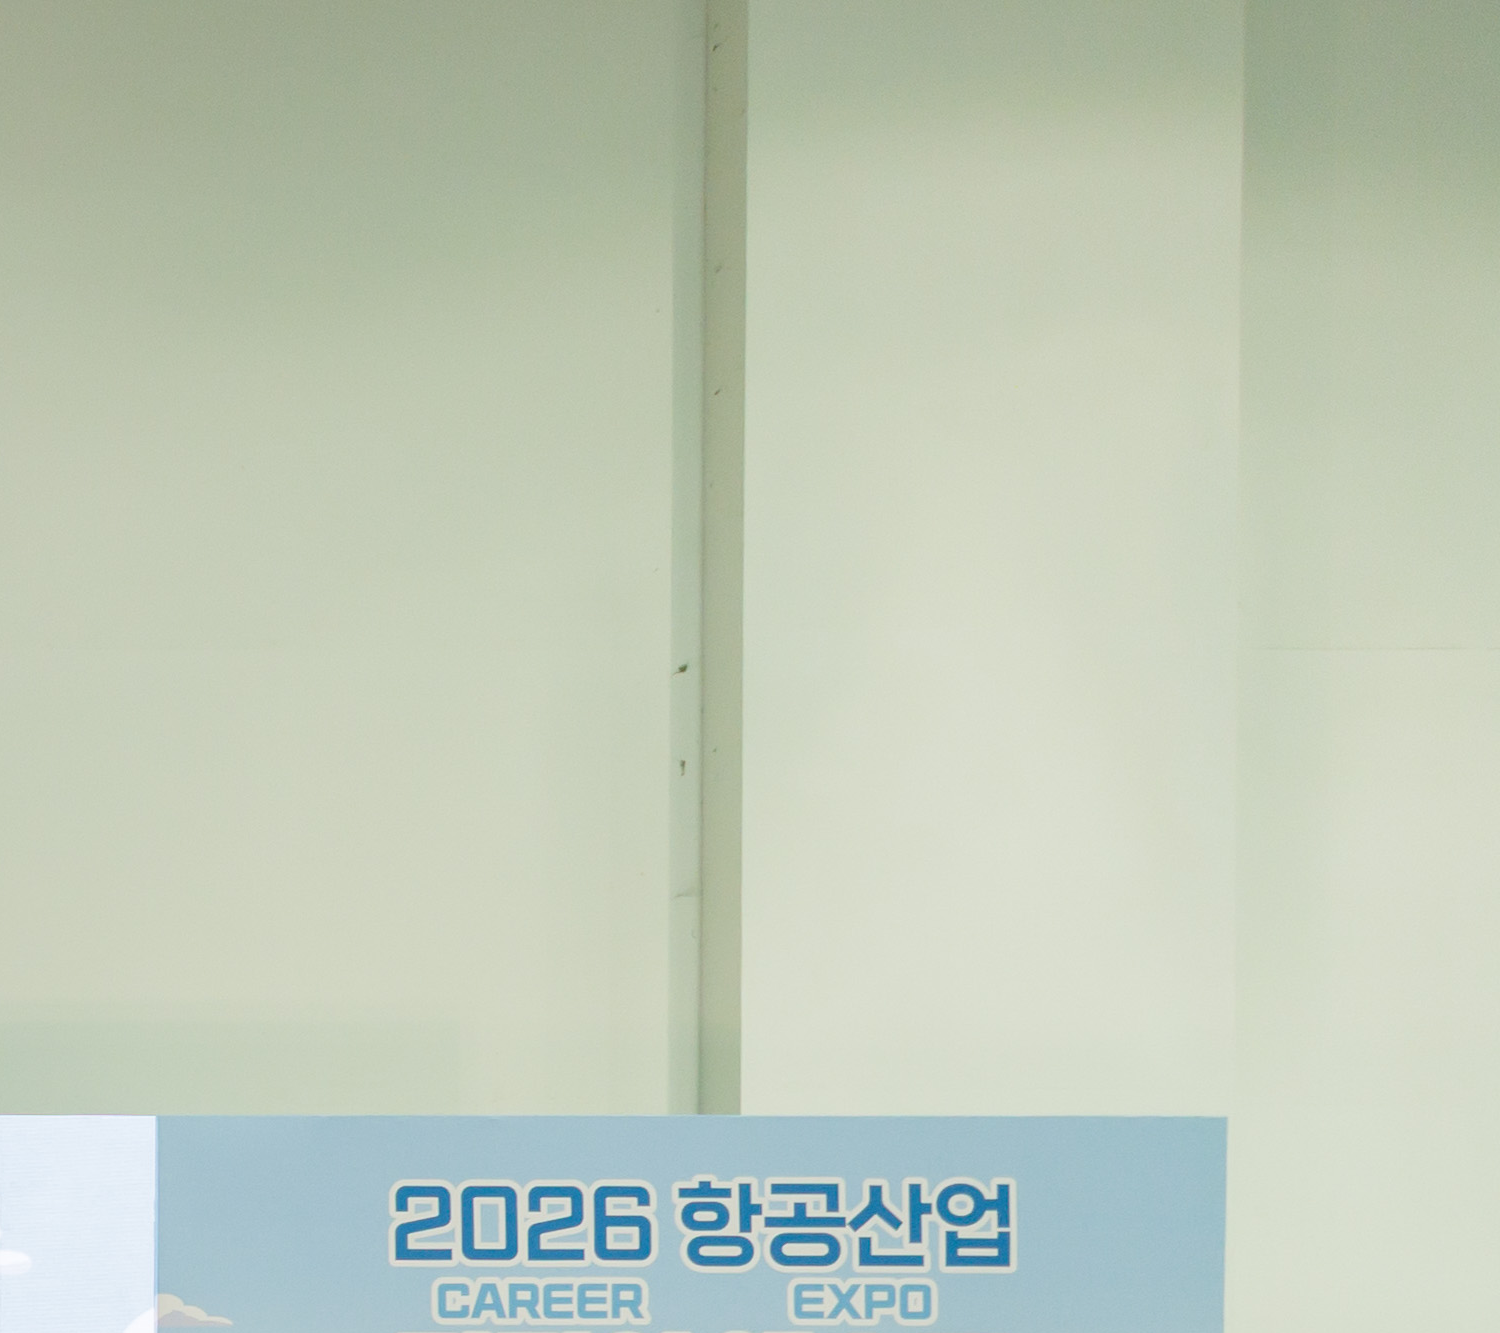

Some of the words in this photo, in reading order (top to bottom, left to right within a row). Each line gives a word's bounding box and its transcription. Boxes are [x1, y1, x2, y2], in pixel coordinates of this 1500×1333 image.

[394, 1183, 654, 1263] 2026
[677, 1179, 1014, 1270] 항공산업
[436, 1282, 644, 1322] CAREER
[792, 1283, 932, 1322] EXPO
